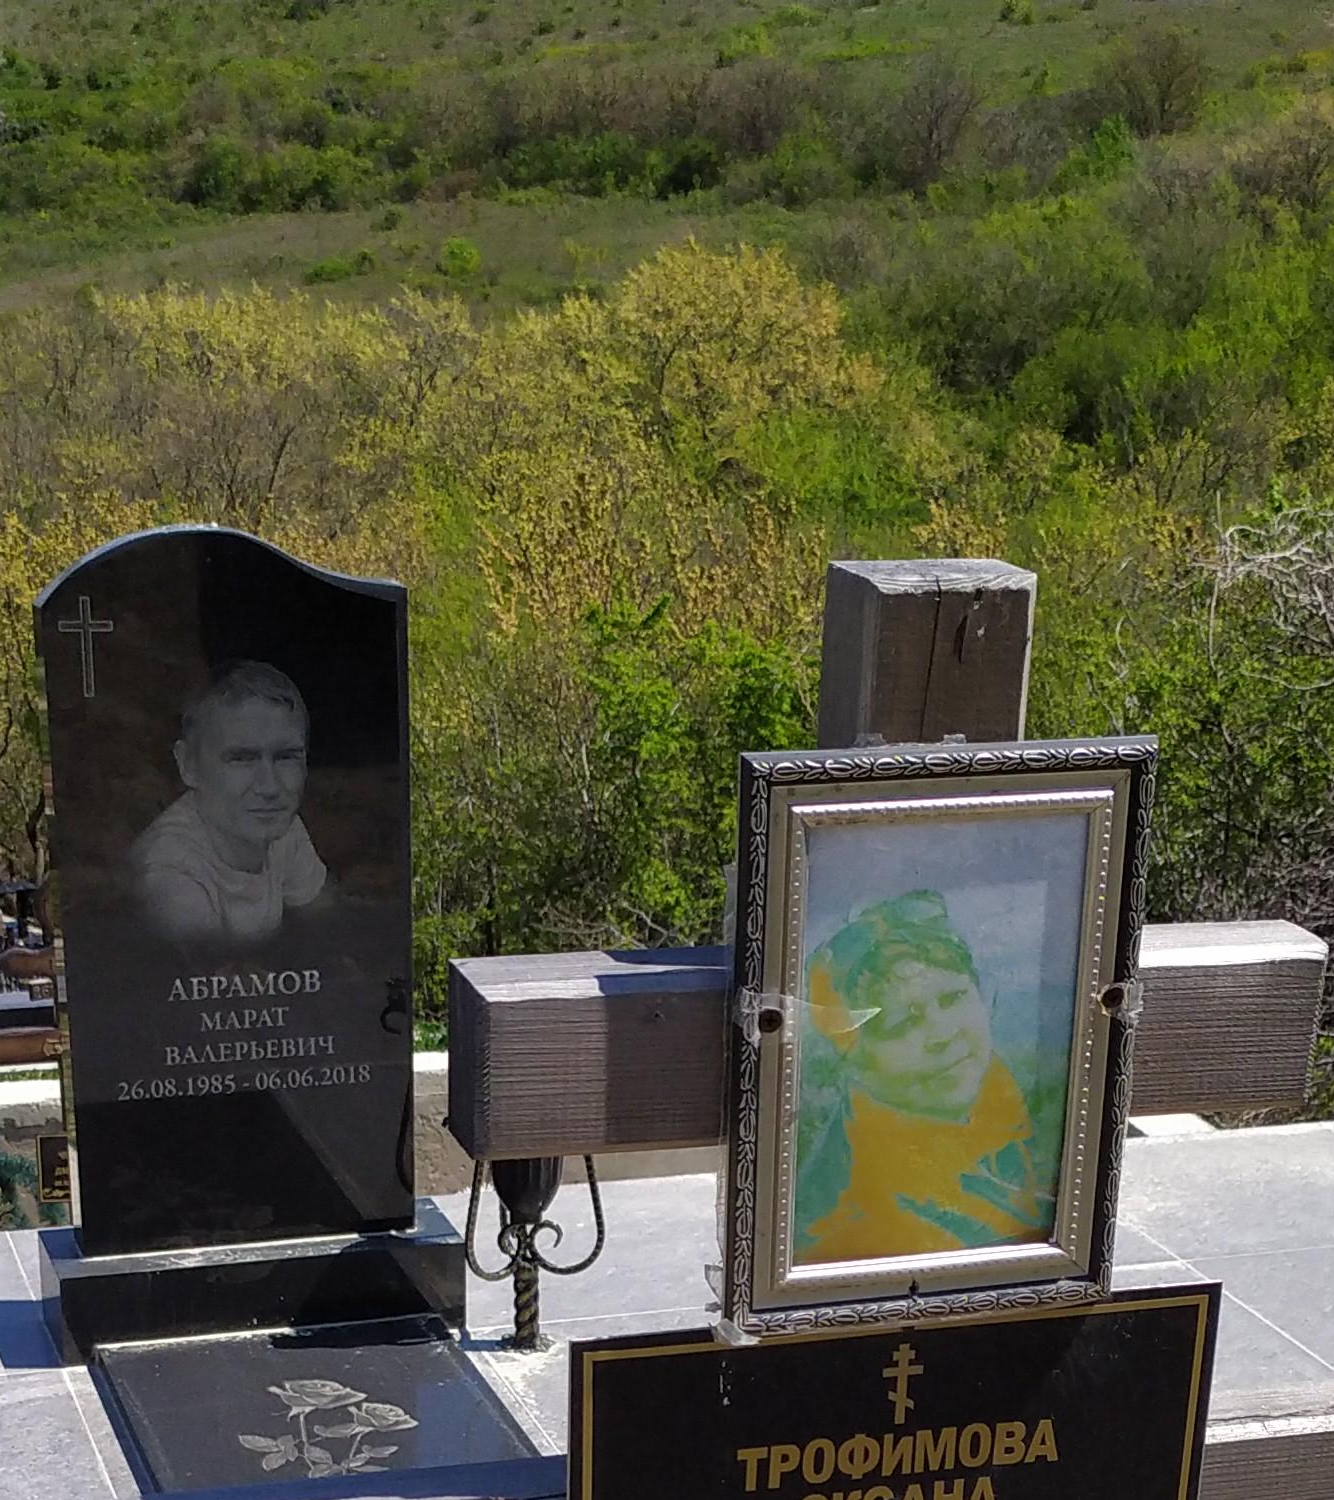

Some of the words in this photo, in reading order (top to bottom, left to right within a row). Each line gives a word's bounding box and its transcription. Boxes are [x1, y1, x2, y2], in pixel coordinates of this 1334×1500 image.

[168, 969, 321, 1001] АБРАМОВ
[200, 1006, 289, 1032] МАРАТ
[164, 1035, 335, 1066] ВАЛЕРЬЕВИЧ
[118, 1073, 236, 1101] 26.08.1985
[255, 1064, 371, 1091] 06.06.2018
[737, 1418, 1059, 1492] ТРОФИМОВА
